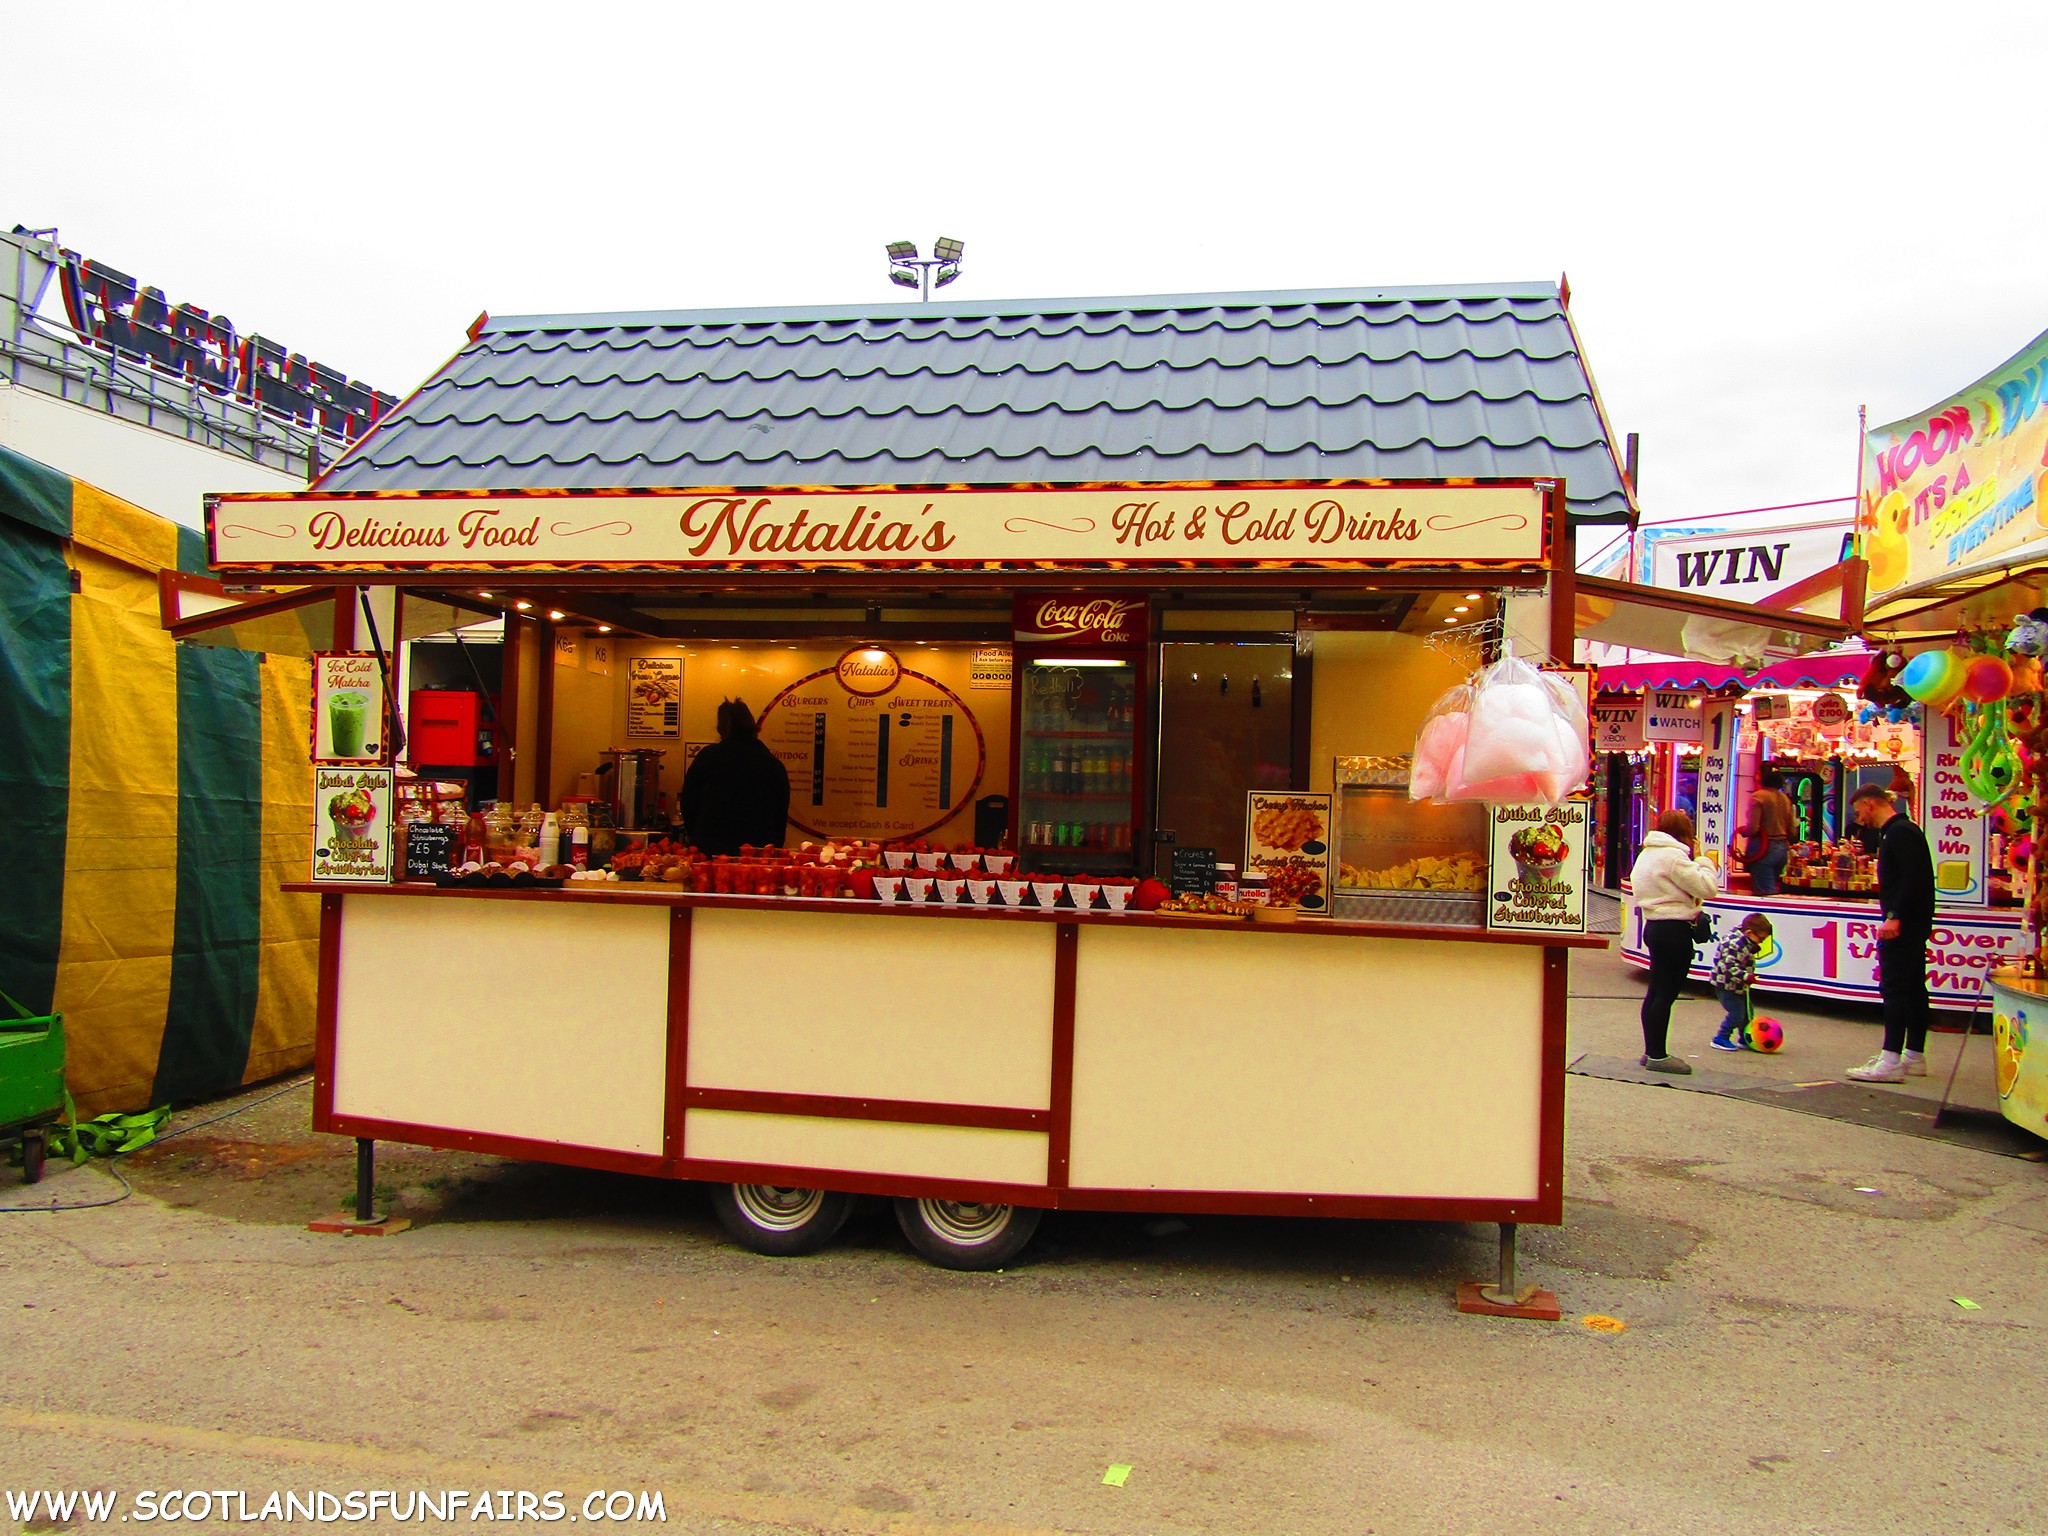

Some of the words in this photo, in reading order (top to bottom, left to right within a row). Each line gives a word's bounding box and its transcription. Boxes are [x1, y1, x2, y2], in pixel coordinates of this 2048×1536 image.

[1876, 405, 1974, 497] HOOK
[1952, 462, 1970, 495] A
[308, 510, 449, 550] Delicious
[457, 508, 541, 549] Food
[679, 497, 956, 558] Natalia's
[1111, 500, 1176, 548] Hot
[1184, 501, 1207, 540] &
[1215, 501, 1295, 544] Cold
[1304, 500, 1423, 545] Drinks
[1675, 543, 1791, 588] WIN
[1036, 599, 1128, 629] Coca-Cola
[1101, 629, 1130, 643] Coke
[595, 646, 607, 662] K6
[327, 660, 345, 673] Ice
[344, 660, 373, 673] Cold
[841, 662, 897, 677] Natalia's
[328, 675, 371, 688] Matcha
[1819, 709, 1842, 717] £100
[1660, 718, 1701, 729] WATCH
[1711, 711, 1723, 750] 1
[1706, 756, 1724, 770] Ring
[1936, 753, 1961, 767] Rin
[319, 772, 355, 789] Dubai
[356, 771, 388, 791] Style
[1704, 772, 1724, 783] Over
[1706, 785, 1720, 798] the
[1940, 787, 1969, 802] the
[1702, 801, 1723, 814] Block
[1931, 805, 1978, 820] Block
[813, 819, 826, 828] We
[829, 820, 857, 830] accept
[860, 820, 882, 829] Cash
[893, 821, 914, 830] Card
[1496, 806, 1542, 824] Dubai
[1544, 806, 1583, 828] Style
[1707, 817, 1716, 829] to
[1704, 831, 1719, 844] Win
[1945, 824, 1963, 837] to
[327, 838, 380, 850] Chocolate
[415, 843, 430, 854] £5
[1938, 839, 1970, 855] Win
[331, 849, 374, 863] Covered
[316, 860, 387, 876] Strawberries
[1214, 882, 1236, 892] tella
[1508, 877, 1573, 895] Chocolate
[1240, 890, 1266, 898] nutella
[1513, 893, 1567, 911] Covered
[1494, 903, 1581, 925] Strawberries
[1928, 928, 2014, 949] Over
[1812, 921, 1838, 979] 1
